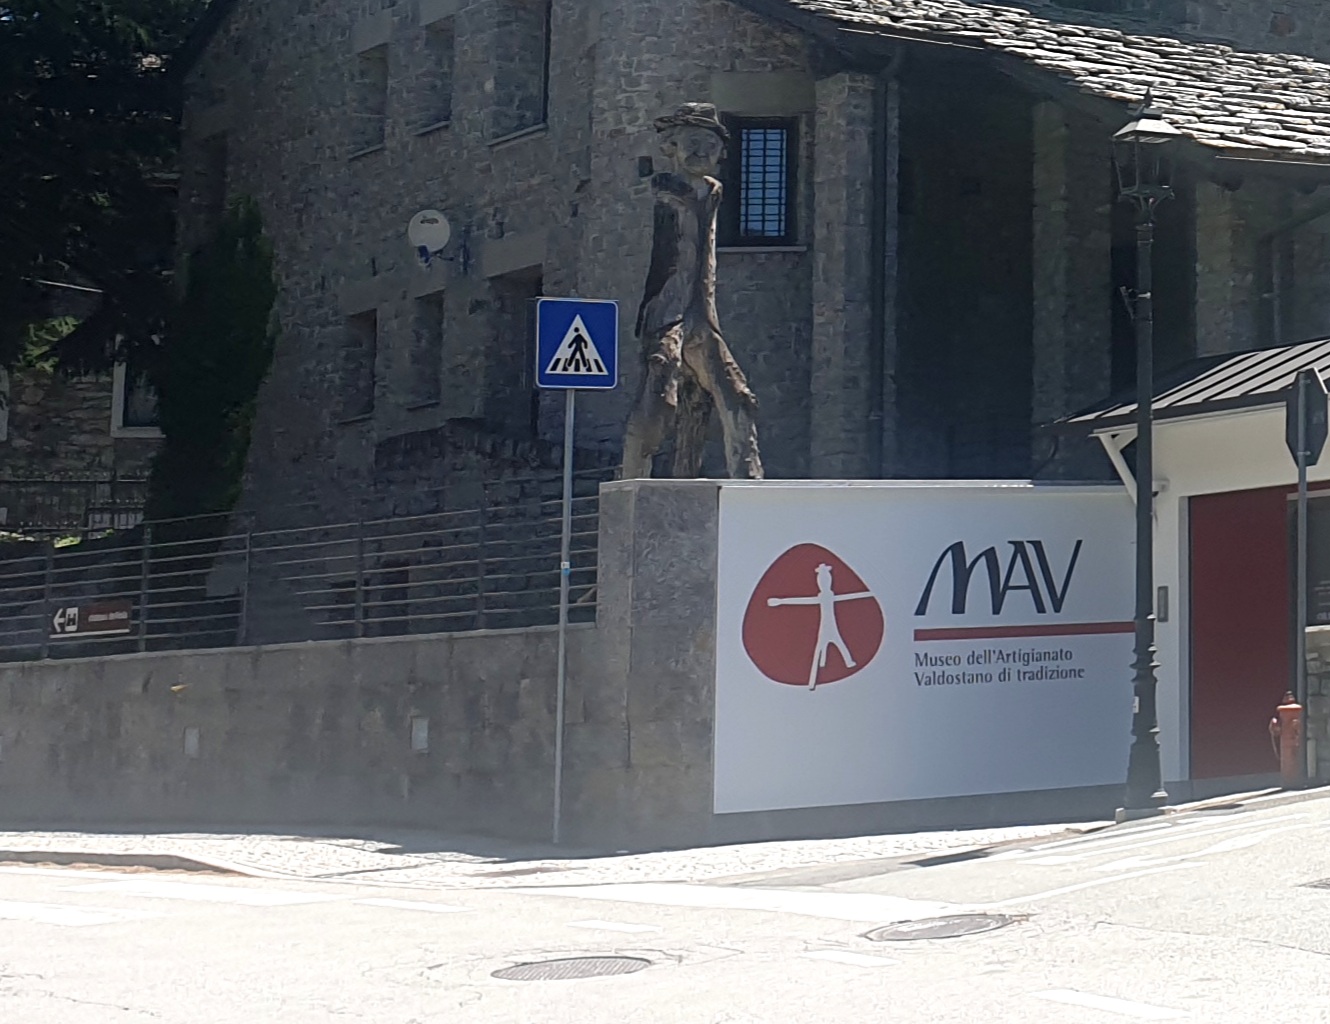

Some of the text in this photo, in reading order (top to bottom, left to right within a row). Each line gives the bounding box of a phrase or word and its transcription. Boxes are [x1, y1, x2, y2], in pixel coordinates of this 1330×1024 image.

[914, 539, 1083, 616] MAV
[914, 648, 1073, 667] Museo dell'Artigianato
[914, 665, 1085, 686] Valdostano di tradizione
